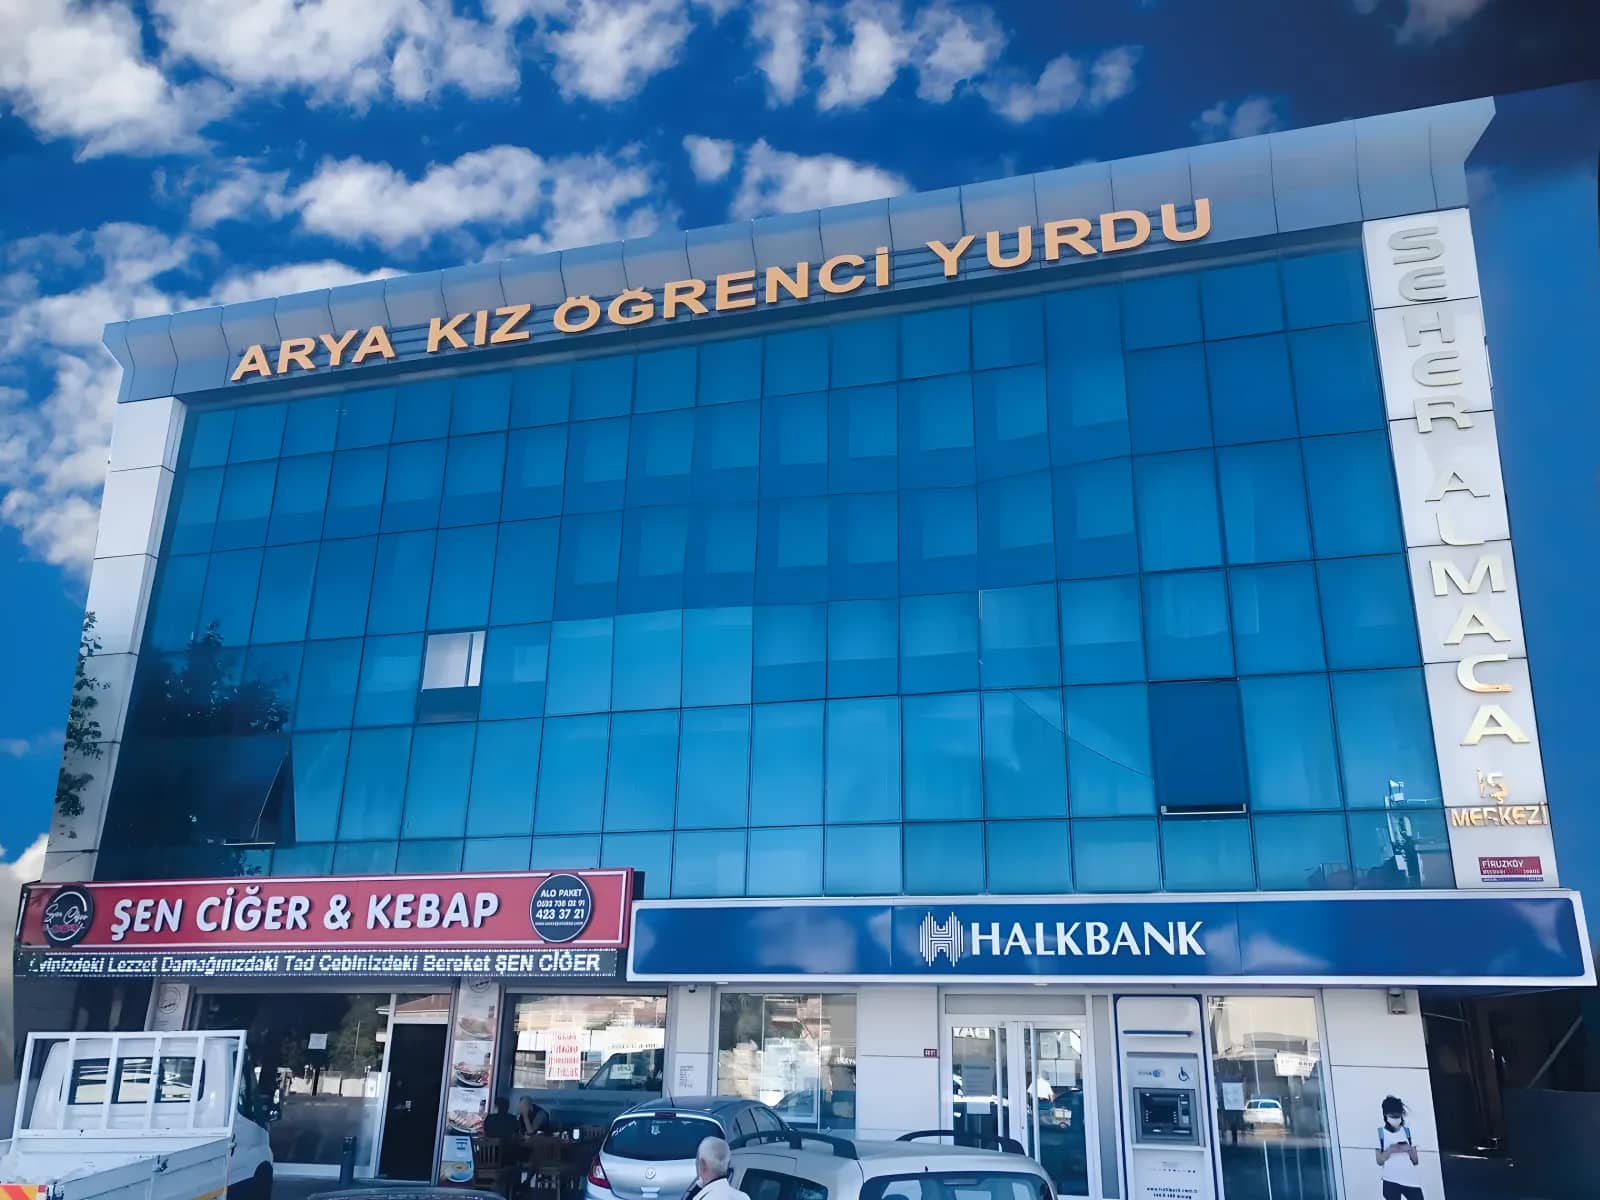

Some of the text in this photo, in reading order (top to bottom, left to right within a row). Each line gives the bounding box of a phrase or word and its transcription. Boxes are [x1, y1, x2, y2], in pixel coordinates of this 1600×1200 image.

[231, 198, 1211, 381] ARYA KIZ ÖĞRENCİ YURDU
[1388, 226, 1531, 746] SEHER ALMACA
[541, 889, 583, 898] ALO PAKET
[110, 885, 500, 942] ŞEN CİĞER & KEBAP
[535, 908, 585, 920] 423 37 21
[971, 921, 1206, 956] HALKBANK
[108, 956, 158, 972] Lezzet
[423, 954, 491, 971] Bereket
[495, 953, 534, 975] ŞEN
